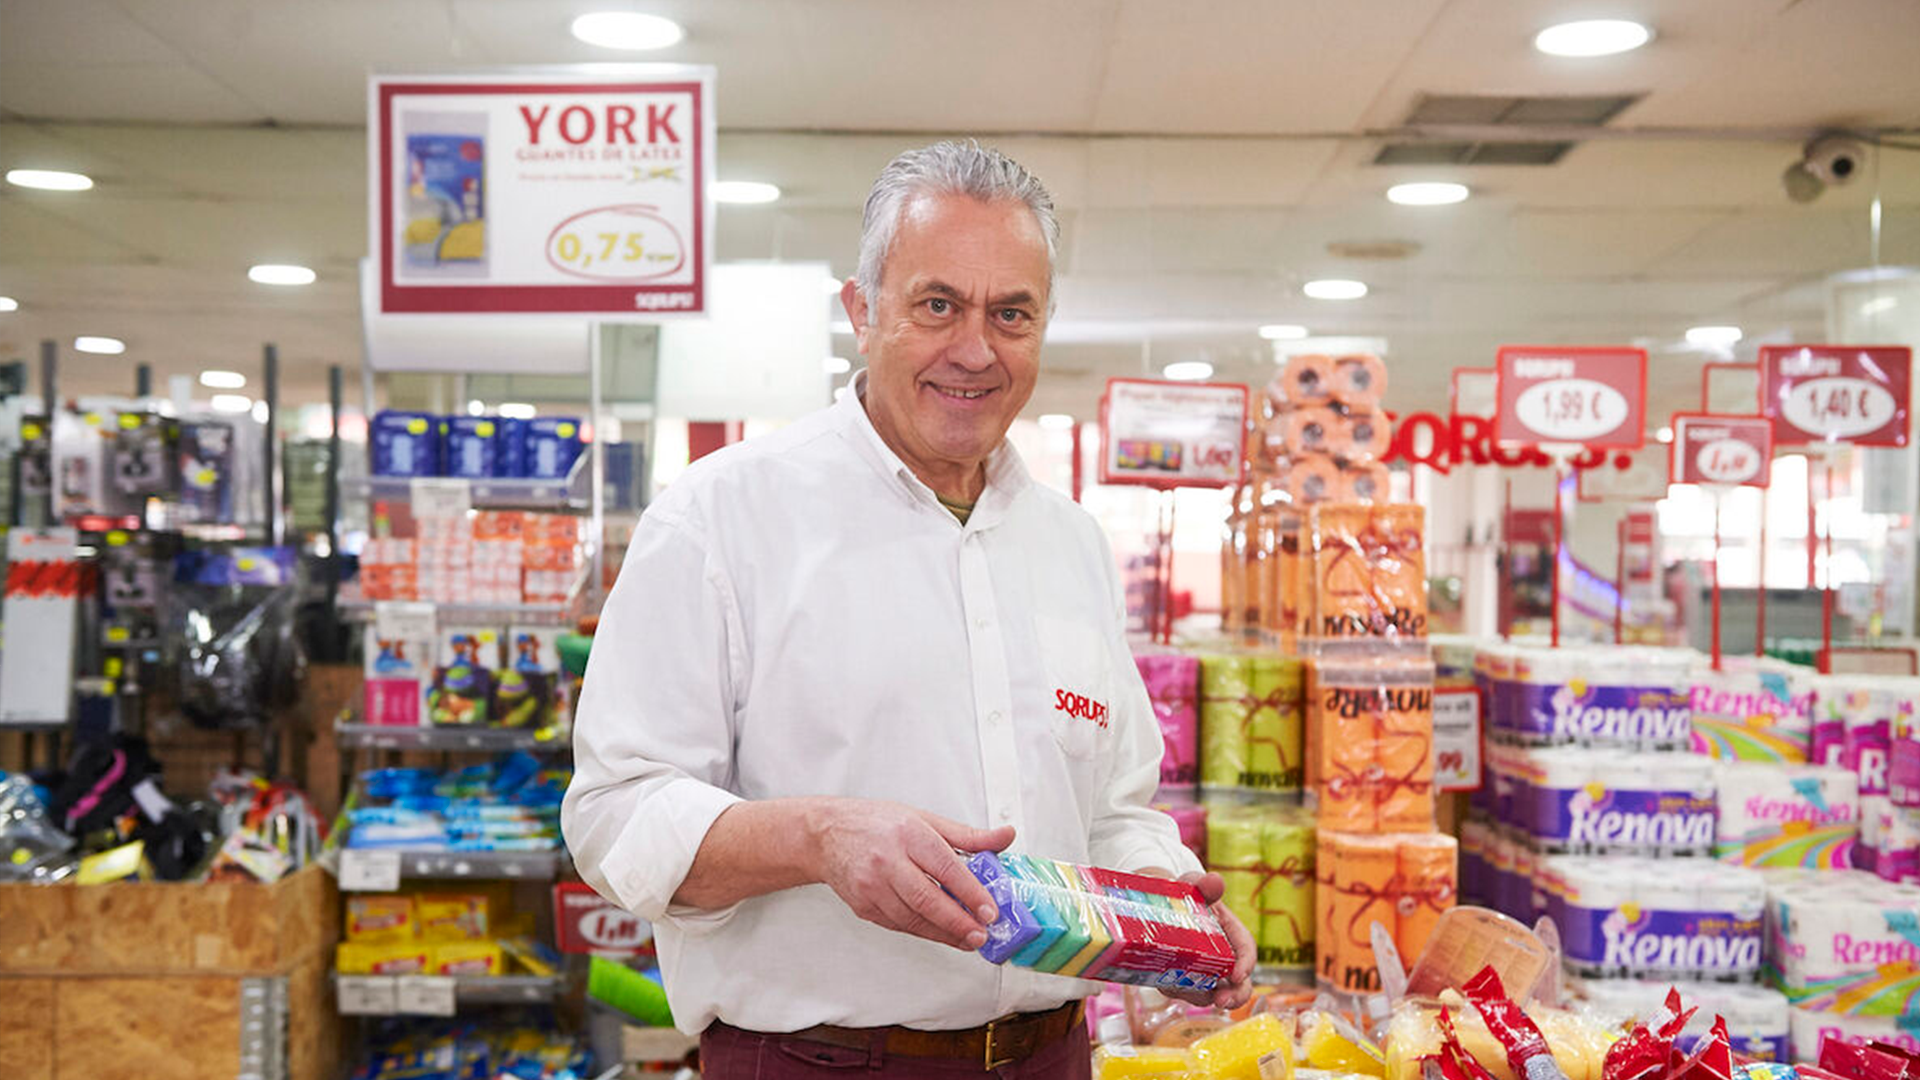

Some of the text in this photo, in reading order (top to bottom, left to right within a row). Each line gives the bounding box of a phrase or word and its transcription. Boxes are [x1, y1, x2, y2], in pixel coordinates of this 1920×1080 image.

[519, 104, 681, 145] YORK
[557, 233, 644, 268] 0,75
[1543, 390, 1583, 424] 1,99
[1553, 700, 1691, 738] Renova
[1569, 807, 1715, 844] Renova
[1604, 927, 1761, 970] Renova
